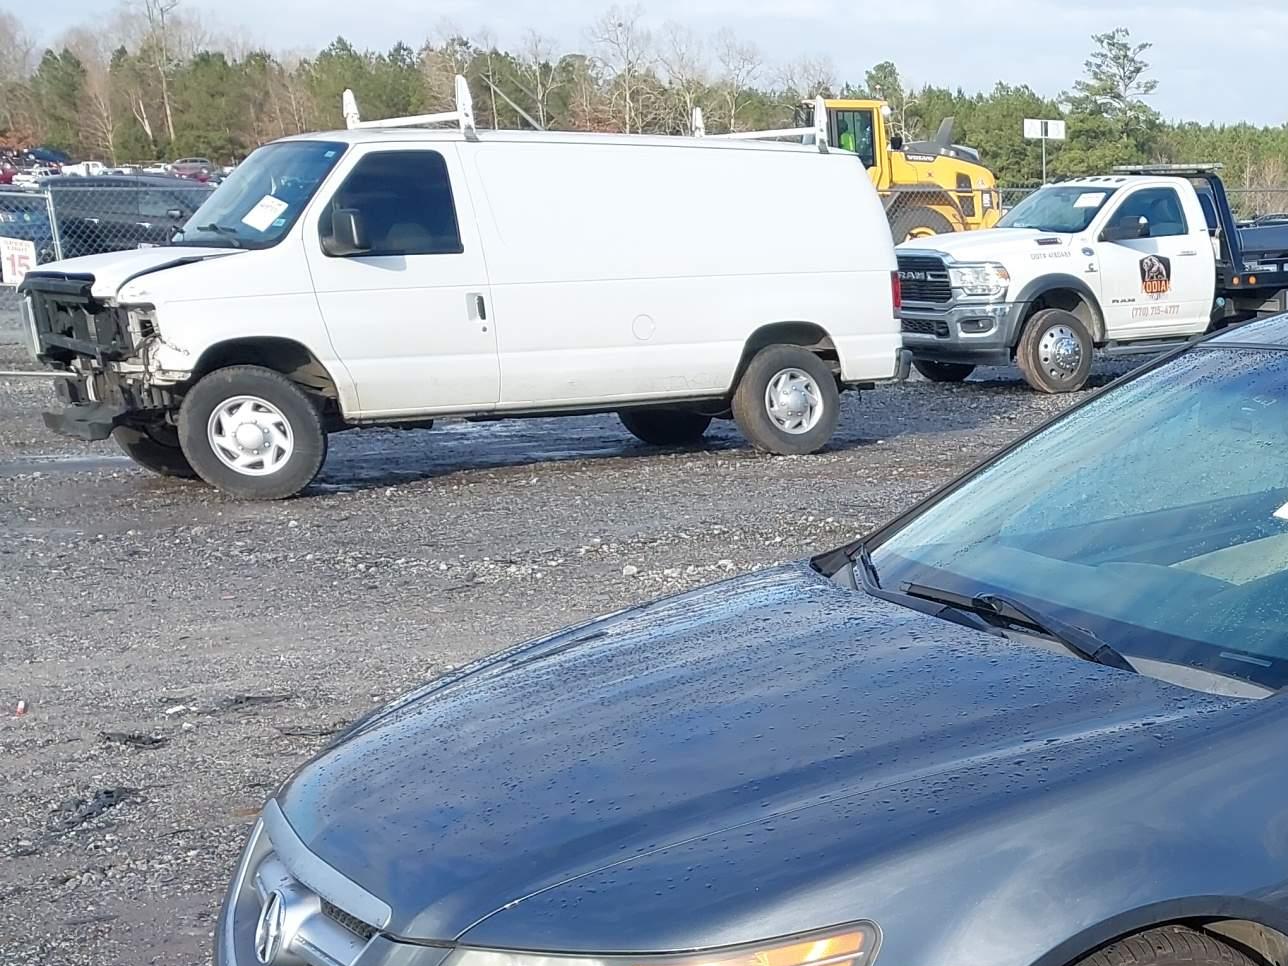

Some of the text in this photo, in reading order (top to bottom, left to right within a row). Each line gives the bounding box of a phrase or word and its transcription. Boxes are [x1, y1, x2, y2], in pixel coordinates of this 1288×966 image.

[906, 154, 935, 162] VOLVO
[6, 253, 31, 277] 15
[898, 270, 928, 282] RAM
